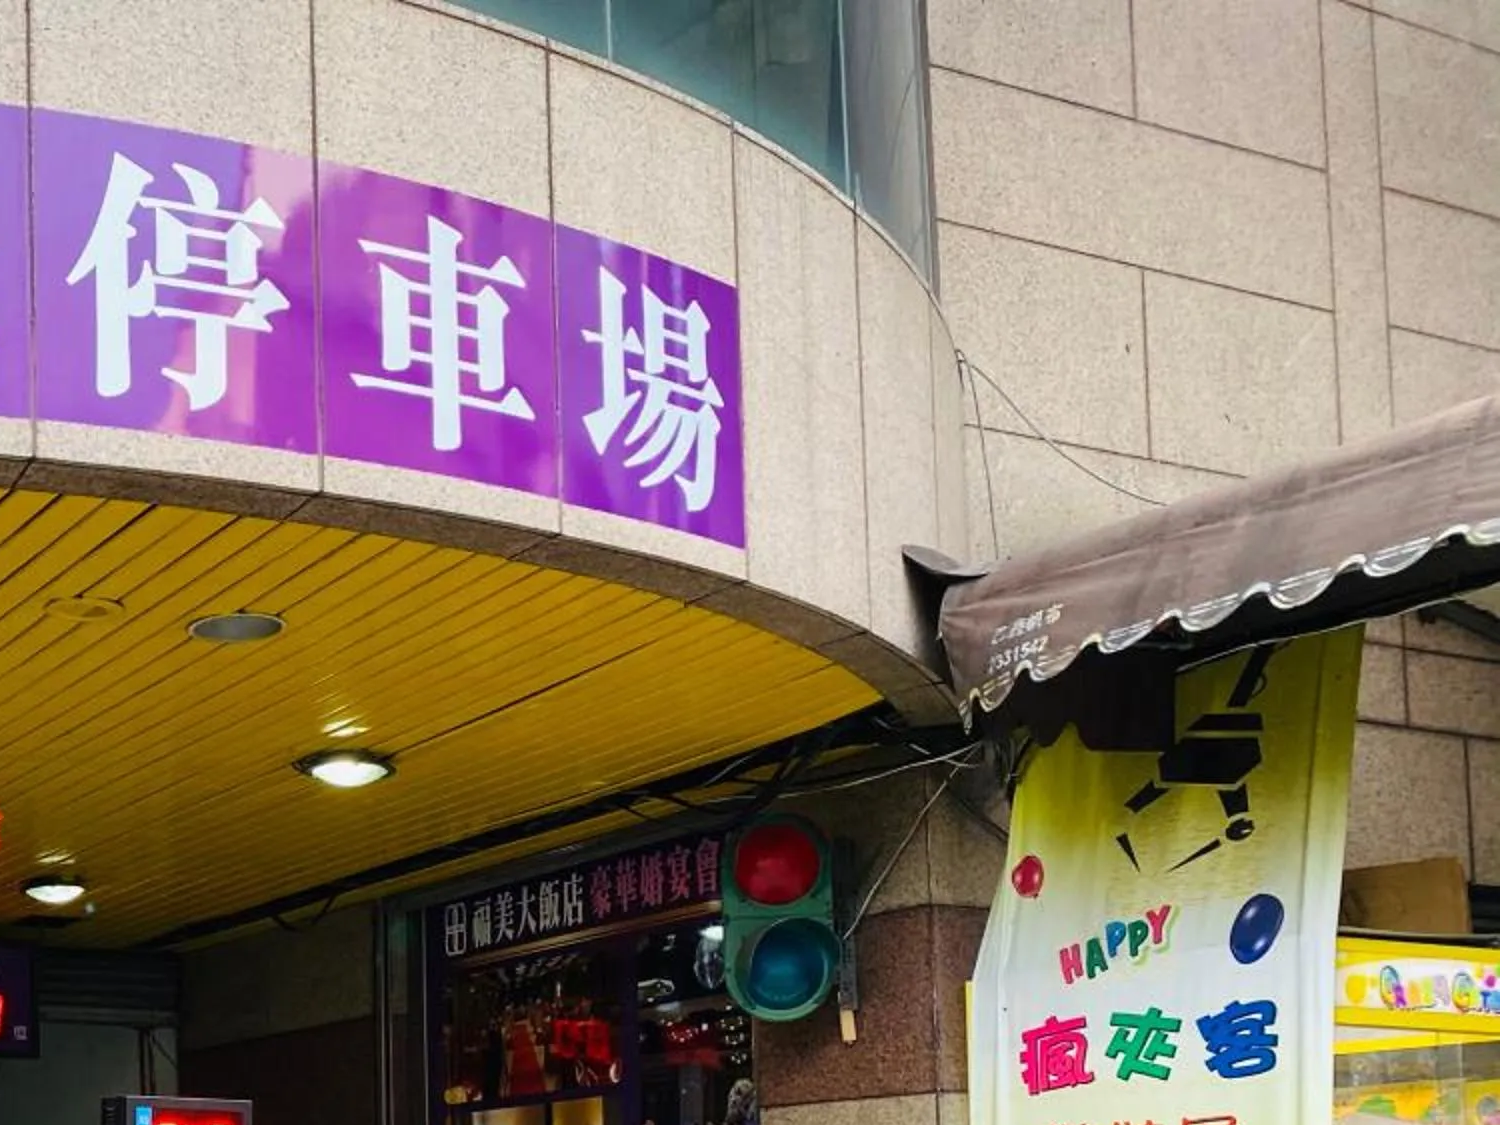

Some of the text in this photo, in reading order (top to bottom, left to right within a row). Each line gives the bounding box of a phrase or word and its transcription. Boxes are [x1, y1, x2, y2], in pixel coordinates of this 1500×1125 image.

[471, 872, 583, 948] 福美大飯店
[1059, 904, 1173, 985] HAPPY
[1020, 999, 1279, 1096] 瘋夾客
